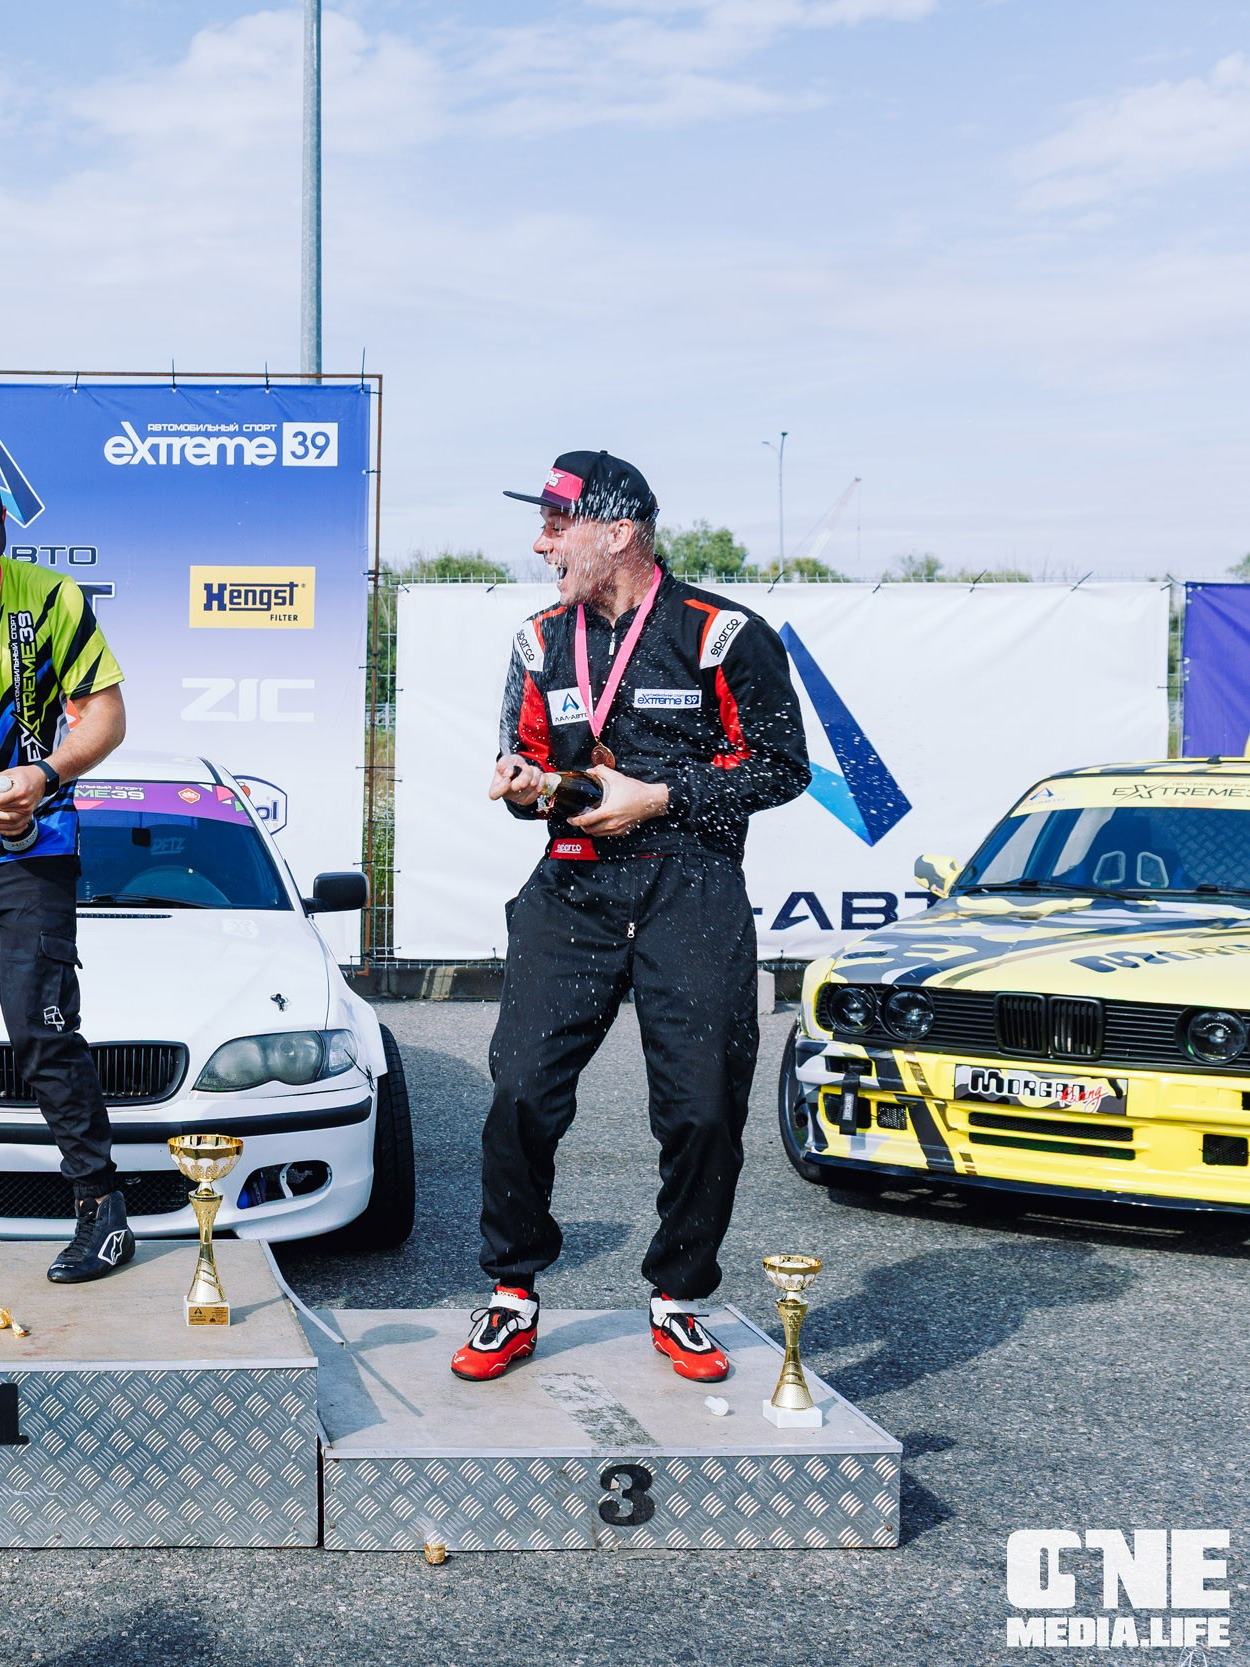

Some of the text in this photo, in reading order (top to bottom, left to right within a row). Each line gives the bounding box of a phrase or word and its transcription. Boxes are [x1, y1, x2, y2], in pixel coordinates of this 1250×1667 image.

[147, 423, 278, 433] АВТОМОБИЛЬНЫЙ СПОРТ
[289, 430, 331, 460] 39
[203, 581, 299, 612] Hengst
[269, 614, 299, 622] FILTER
[516, 629, 535, 663] sparco
[711, 618, 741, 657] sparco
[180, 677, 315, 723] ZIC
[685, 695, 699, 705] 39
[1112, 782, 1250, 802] EXTREME
[598, 1463, 656, 1527] 3
